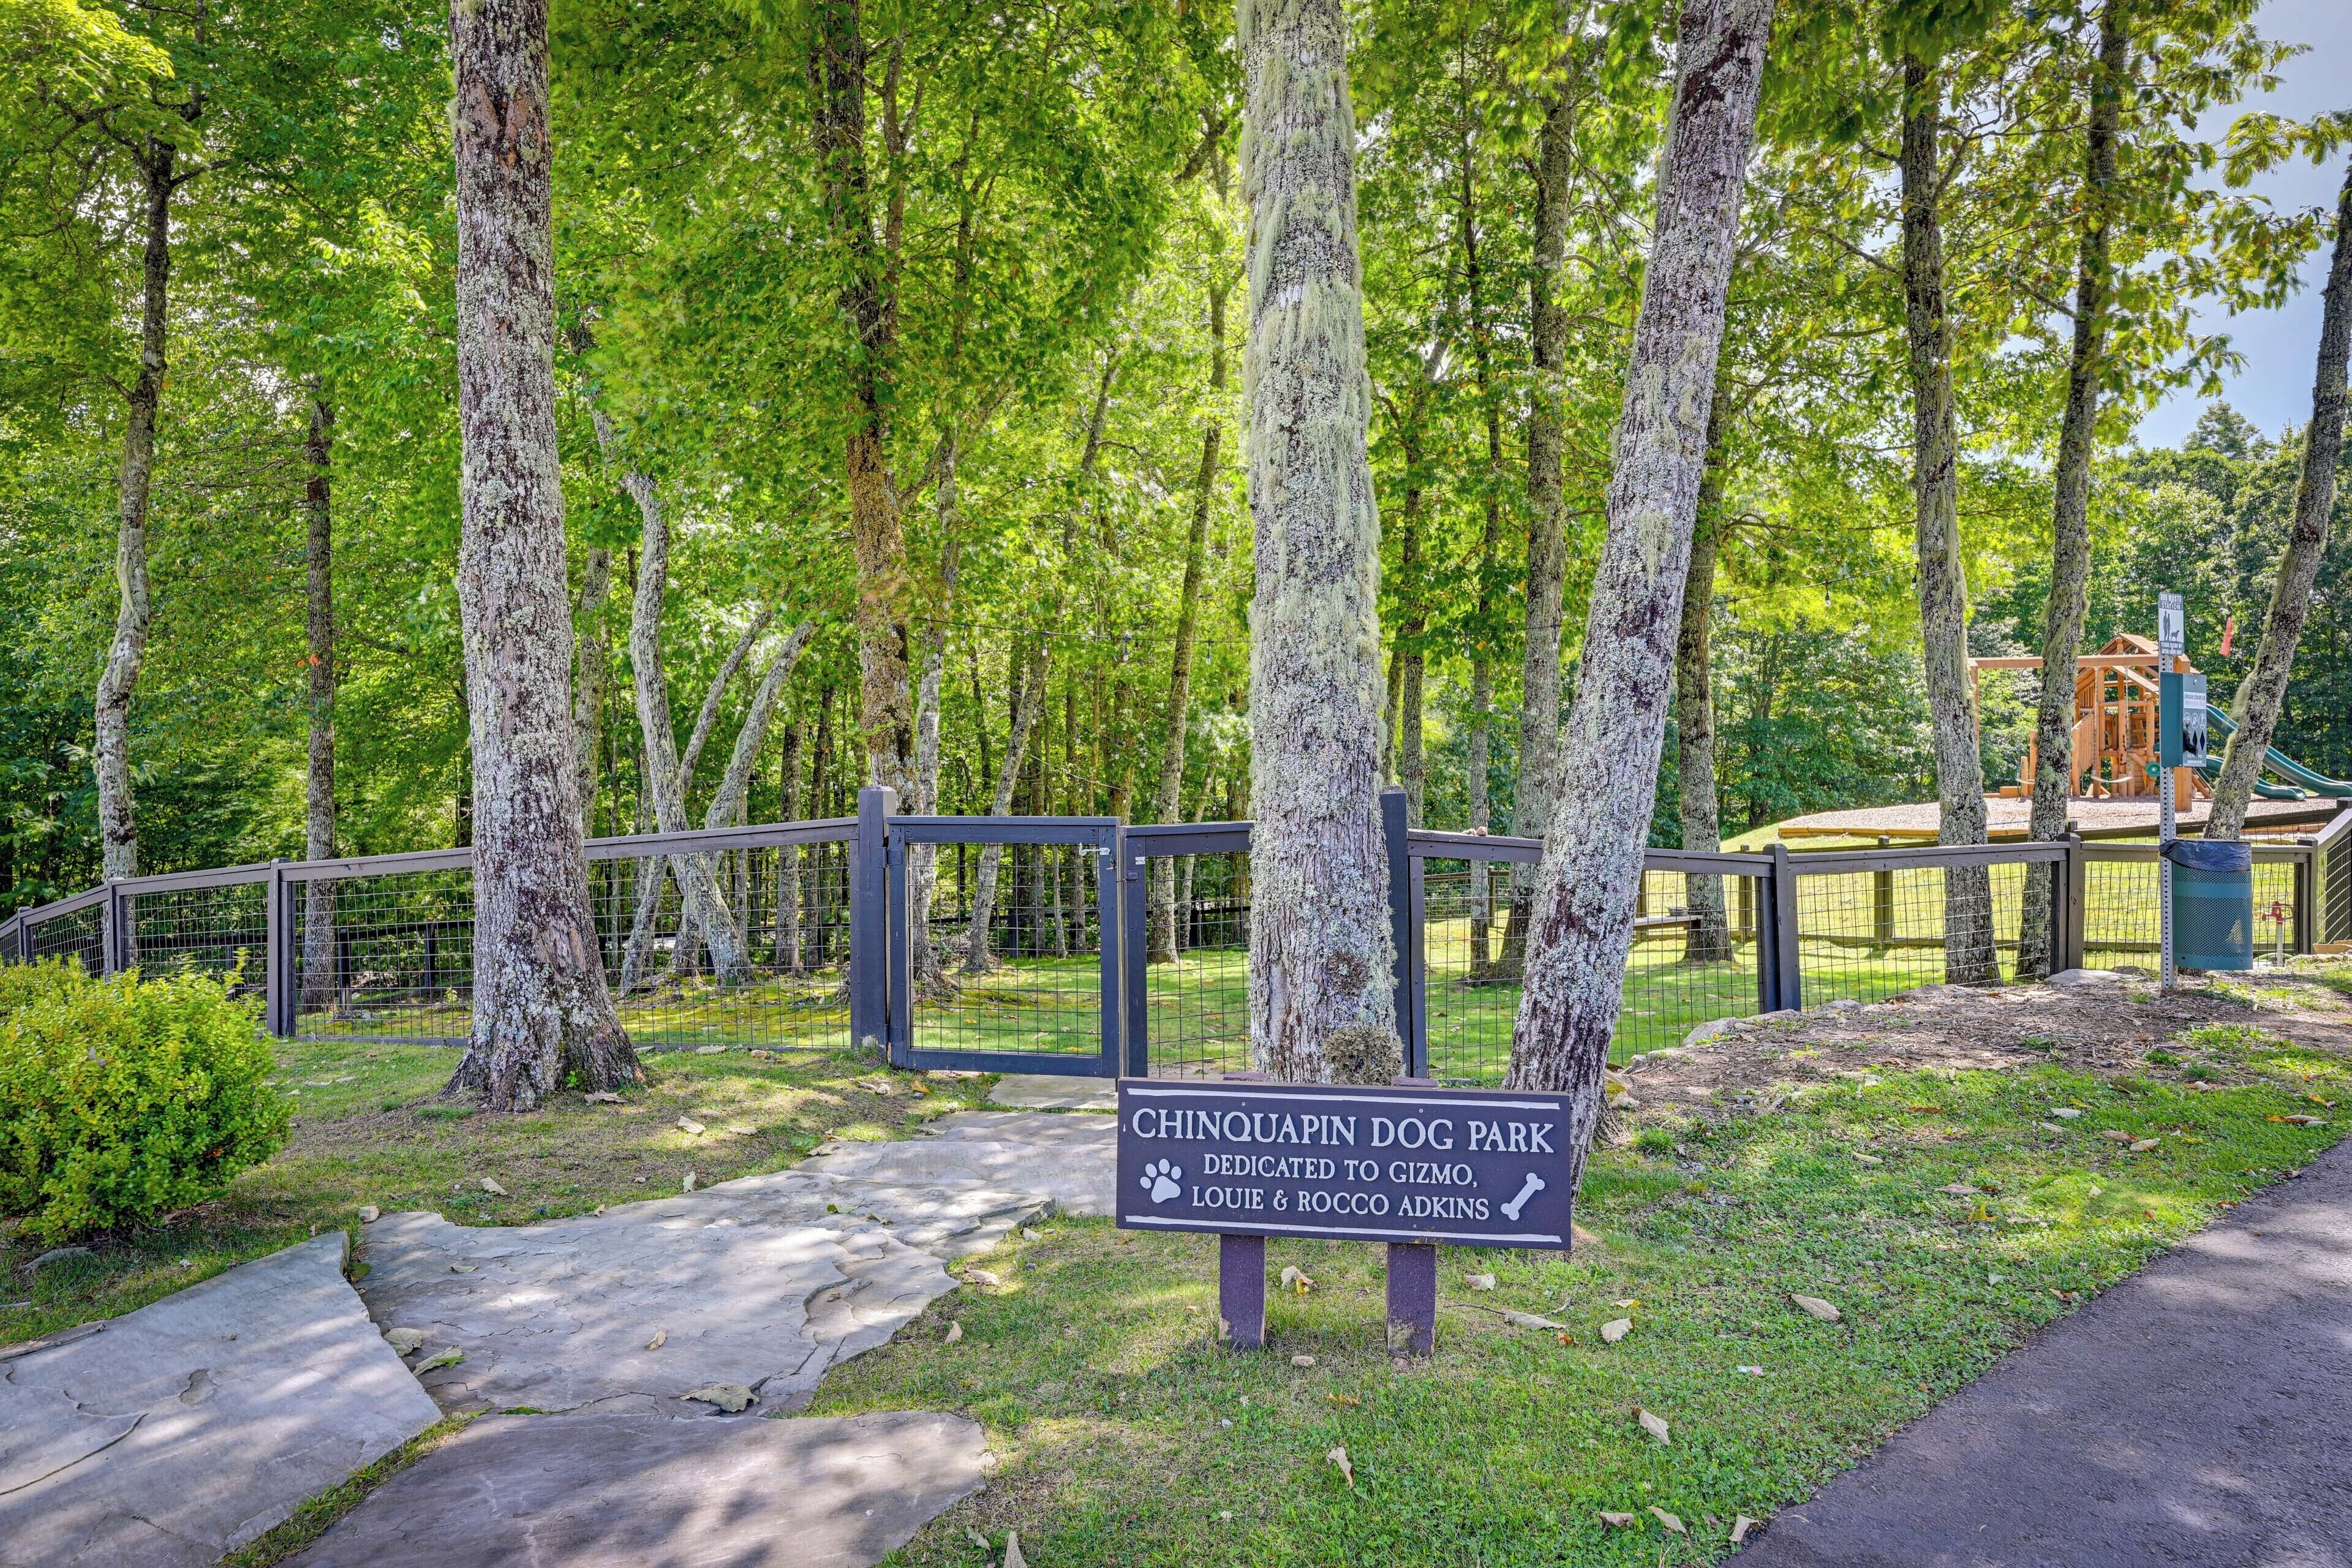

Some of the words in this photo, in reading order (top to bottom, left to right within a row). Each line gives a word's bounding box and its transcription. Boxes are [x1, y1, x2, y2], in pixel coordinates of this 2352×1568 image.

[2168, 594, 2181, 603] WASTE
[1132, 1107, 1357, 1146] CHINQUAPIN
[1371, 1117, 1453, 1150] DOG
[1467, 1121, 1554, 1153] PARK
[1203, 1153, 1335, 1179] DEDICATED
[1344, 1159, 1379, 1182] TO
[1389, 1161, 1478, 1188] GIZMO,
[1192, 1186, 1264, 1210] LOUIE
[1273, 1189, 1289, 1211] &
[1297, 1191, 1389, 1215] ROCCO
[1398, 1195, 1490, 1220] ADKINS
